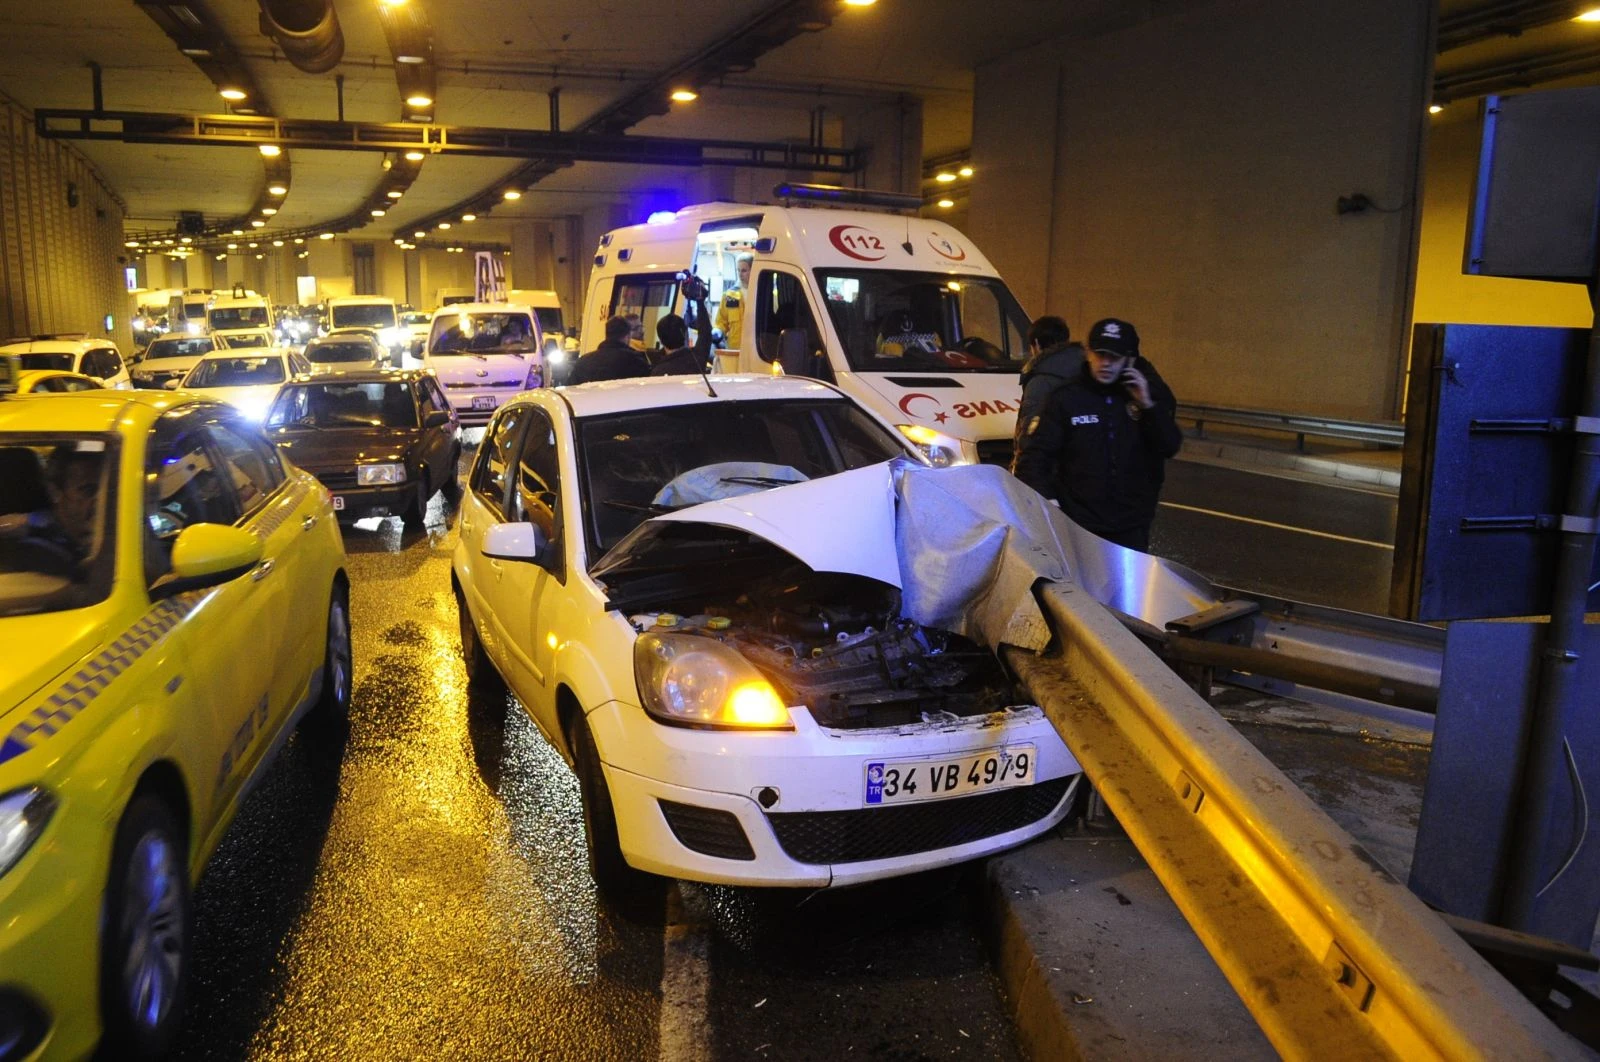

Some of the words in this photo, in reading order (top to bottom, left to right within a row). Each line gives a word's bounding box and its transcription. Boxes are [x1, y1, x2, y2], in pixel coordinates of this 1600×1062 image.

[844, 234, 885, 250] 112
[868, 785, 881, 795] TR
[884, 768, 916, 796] 34
[930, 764, 960, 792] VB
[967, 753, 1029, 785] 4979
